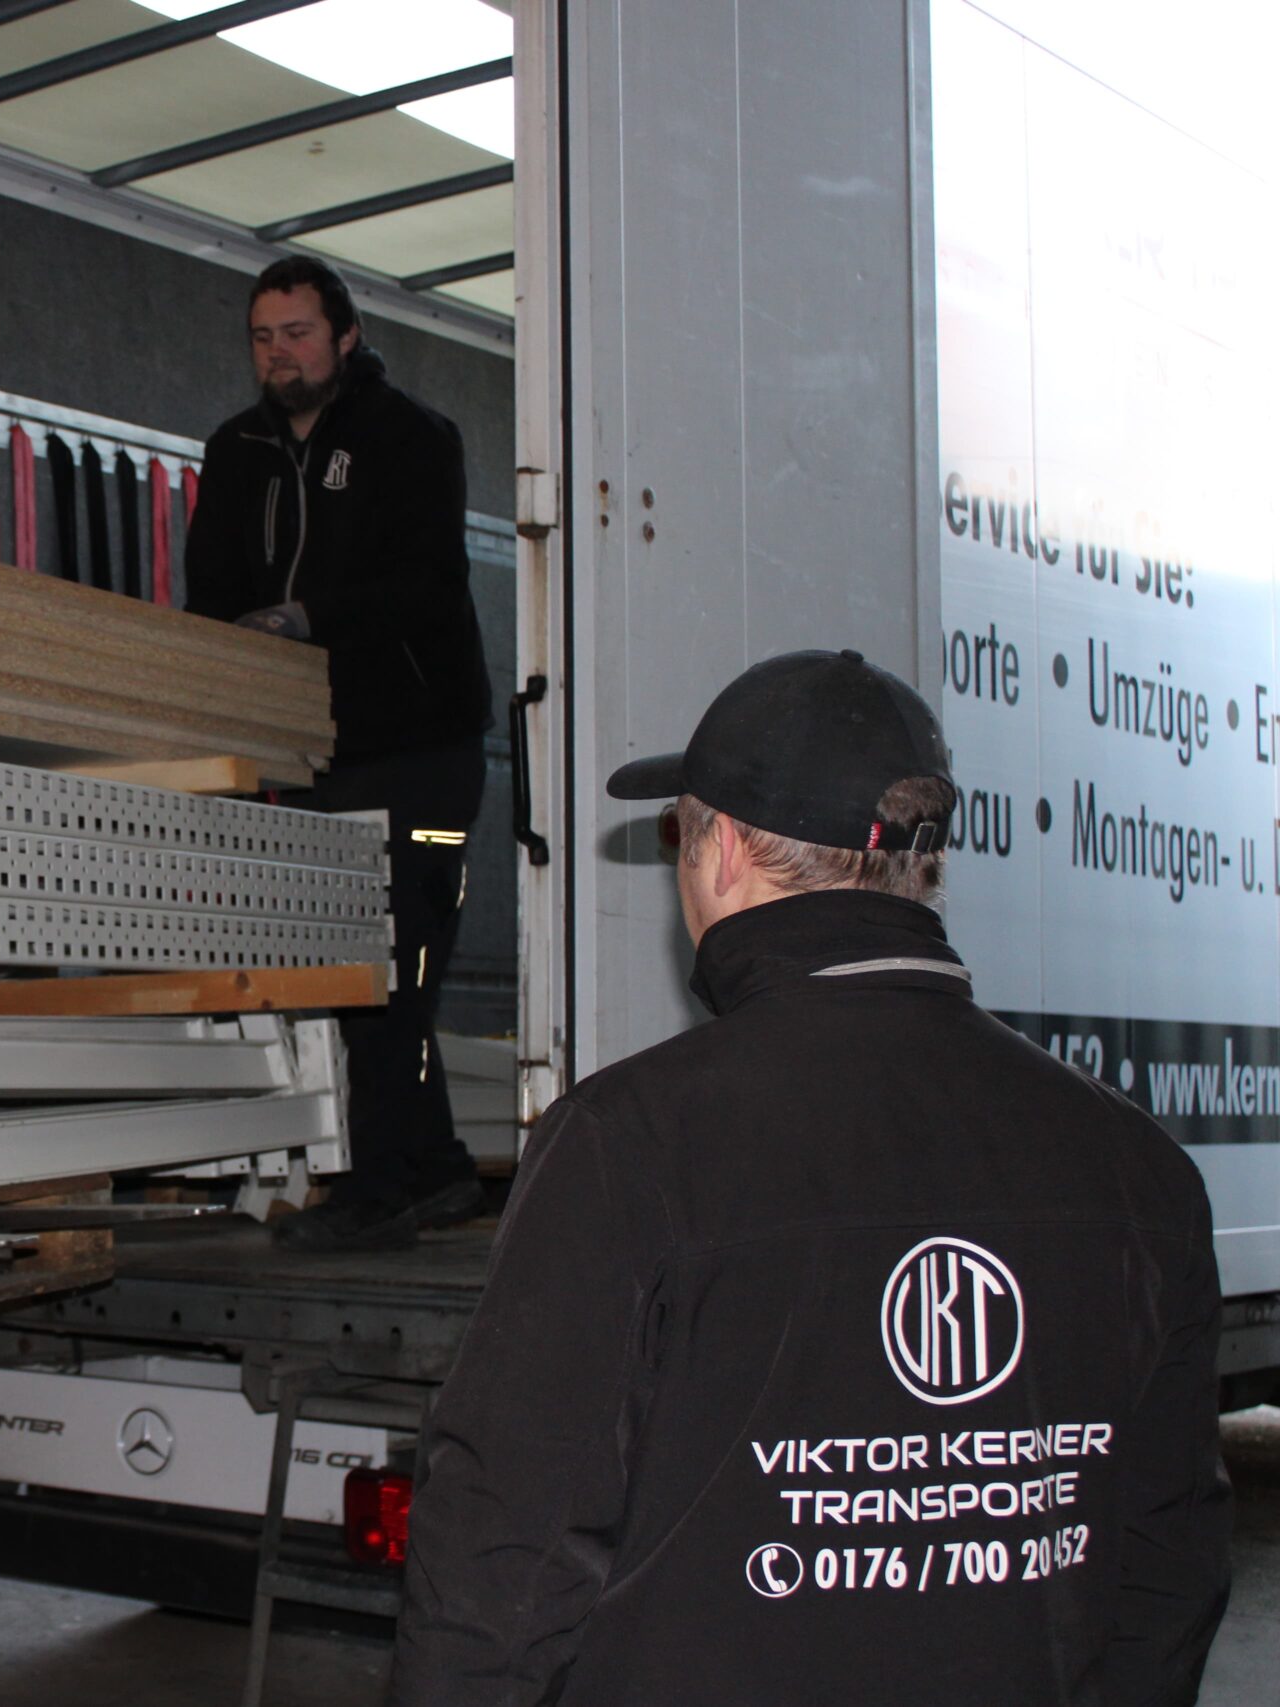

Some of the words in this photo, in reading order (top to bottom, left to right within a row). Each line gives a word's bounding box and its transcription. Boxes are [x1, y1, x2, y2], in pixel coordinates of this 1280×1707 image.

[943, 467, 1061, 566] ervice
[943, 621, 1020, 707] orte
[1088, 636, 1209, 767] Umzüge
[1072, 779, 1231, 902] Montagen-
[1241, 836, 1264, 894] u.
[751, 1434, 929, 1474] VIKTOR
[940, 1422, 1113, 1466] KERNER
[780, 1471, 1080, 1525] TRANSPORTE
[814, 1546, 908, 1590] 0176
[943, 1540, 1009, 1586] 700
